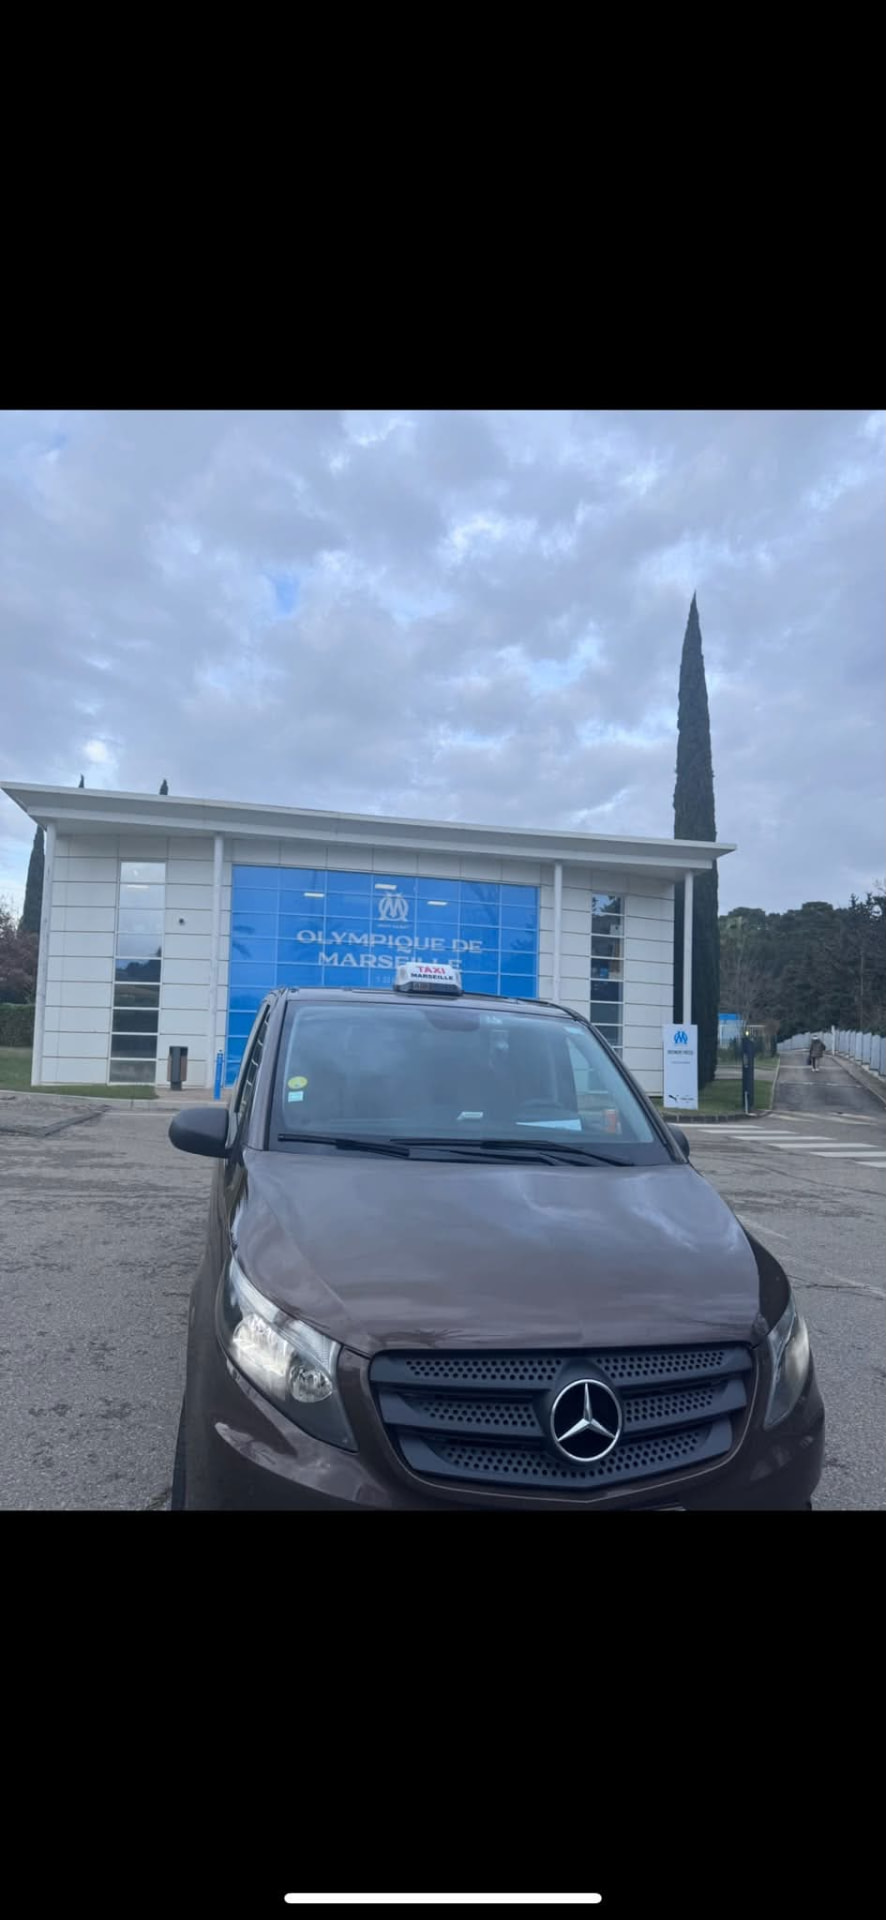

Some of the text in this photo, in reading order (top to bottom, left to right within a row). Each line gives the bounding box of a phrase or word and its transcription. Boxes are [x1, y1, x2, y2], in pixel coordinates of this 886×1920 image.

[296, 929, 483, 954] OLYMPIQUE DE
[418, 966, 446, 975] TAXI
[410, 973, 454, 981] MARSEILLE
